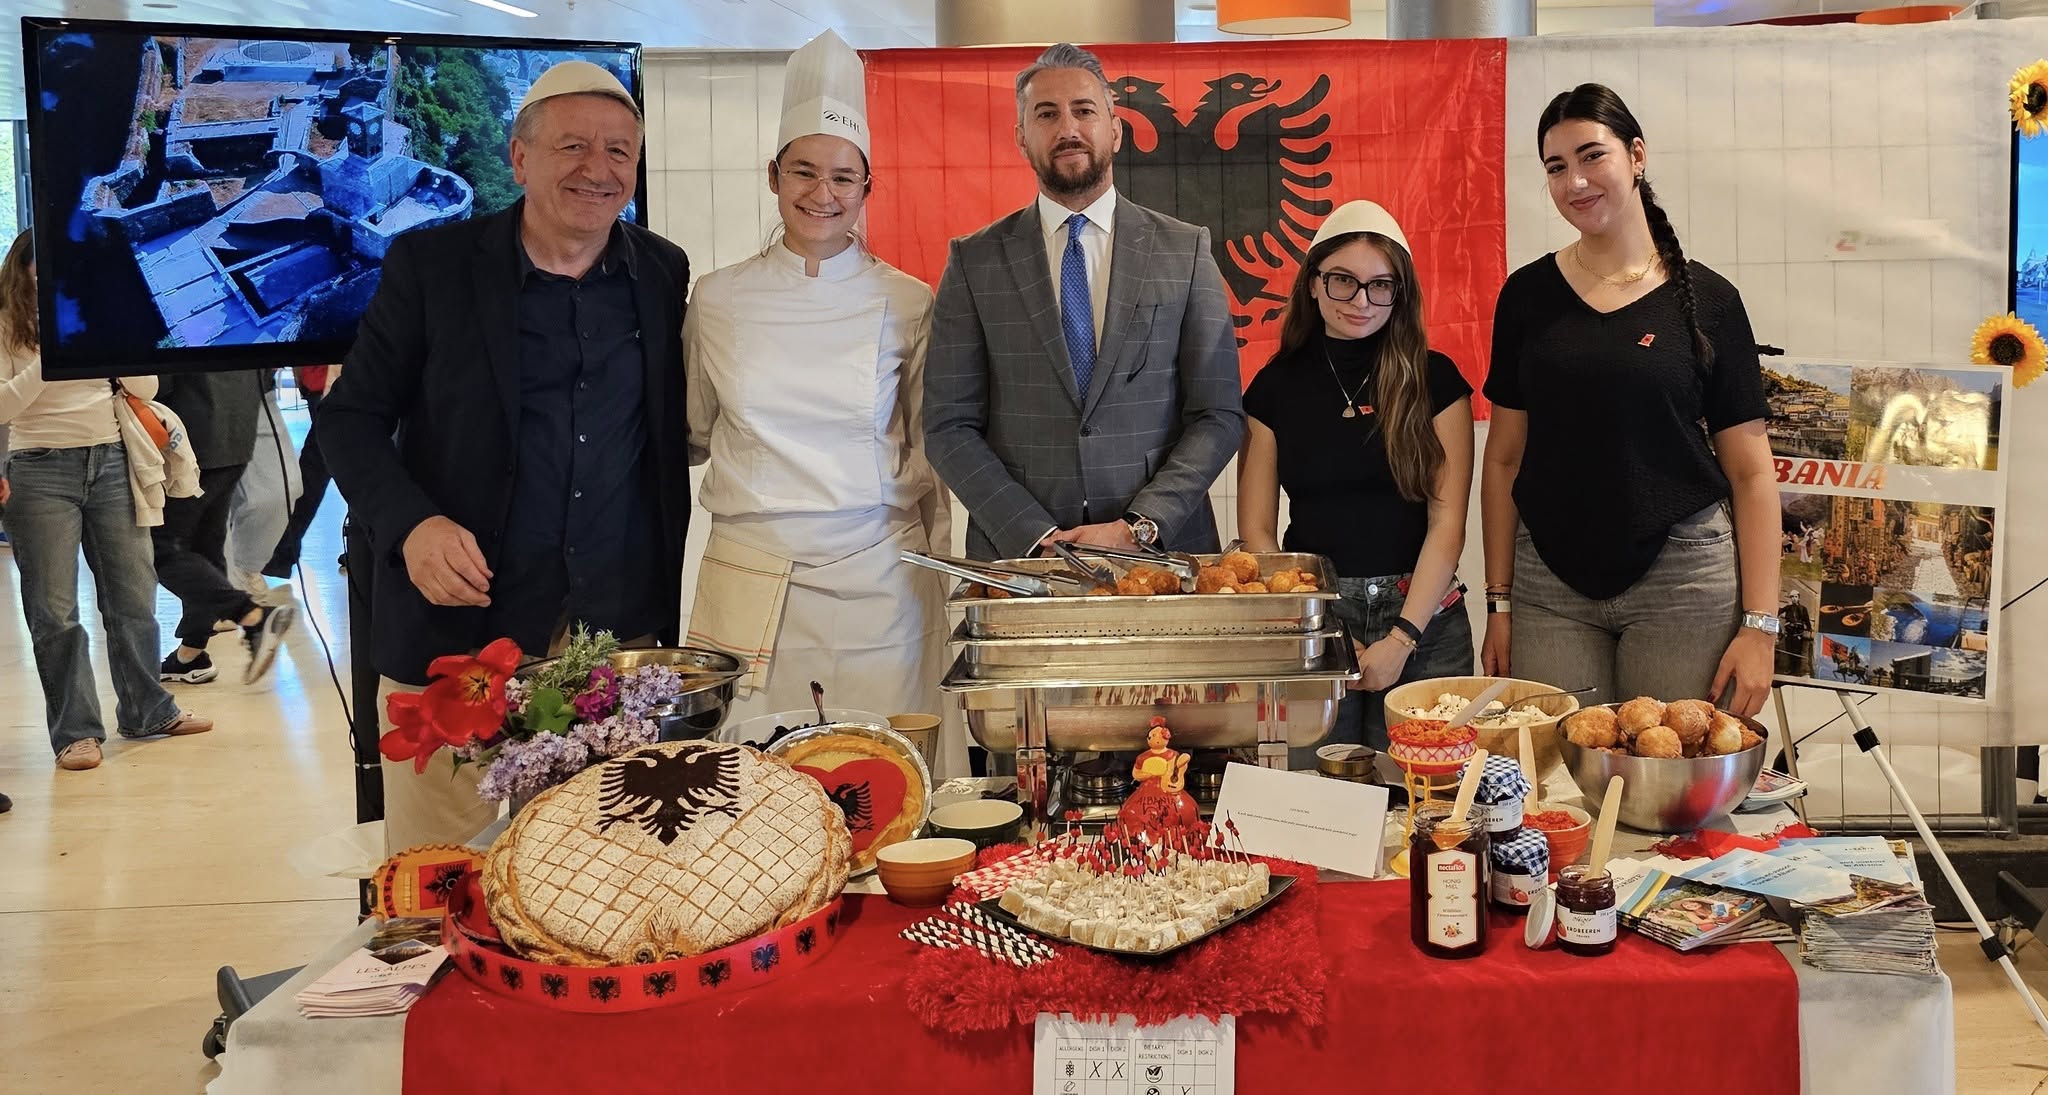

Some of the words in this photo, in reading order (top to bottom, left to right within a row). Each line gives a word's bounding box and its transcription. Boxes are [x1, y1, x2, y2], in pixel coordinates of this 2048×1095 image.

[842, 116, 862, 135] EHL
[1773, 458, 1888, 490] BANIA
[1438, 862, 1466, 871] nectaflor
[1567, 926, 1601, 934] ERDBEEREN
[356, 966, 381, 974] LES
[383, 963, 427, 972] ALPES
